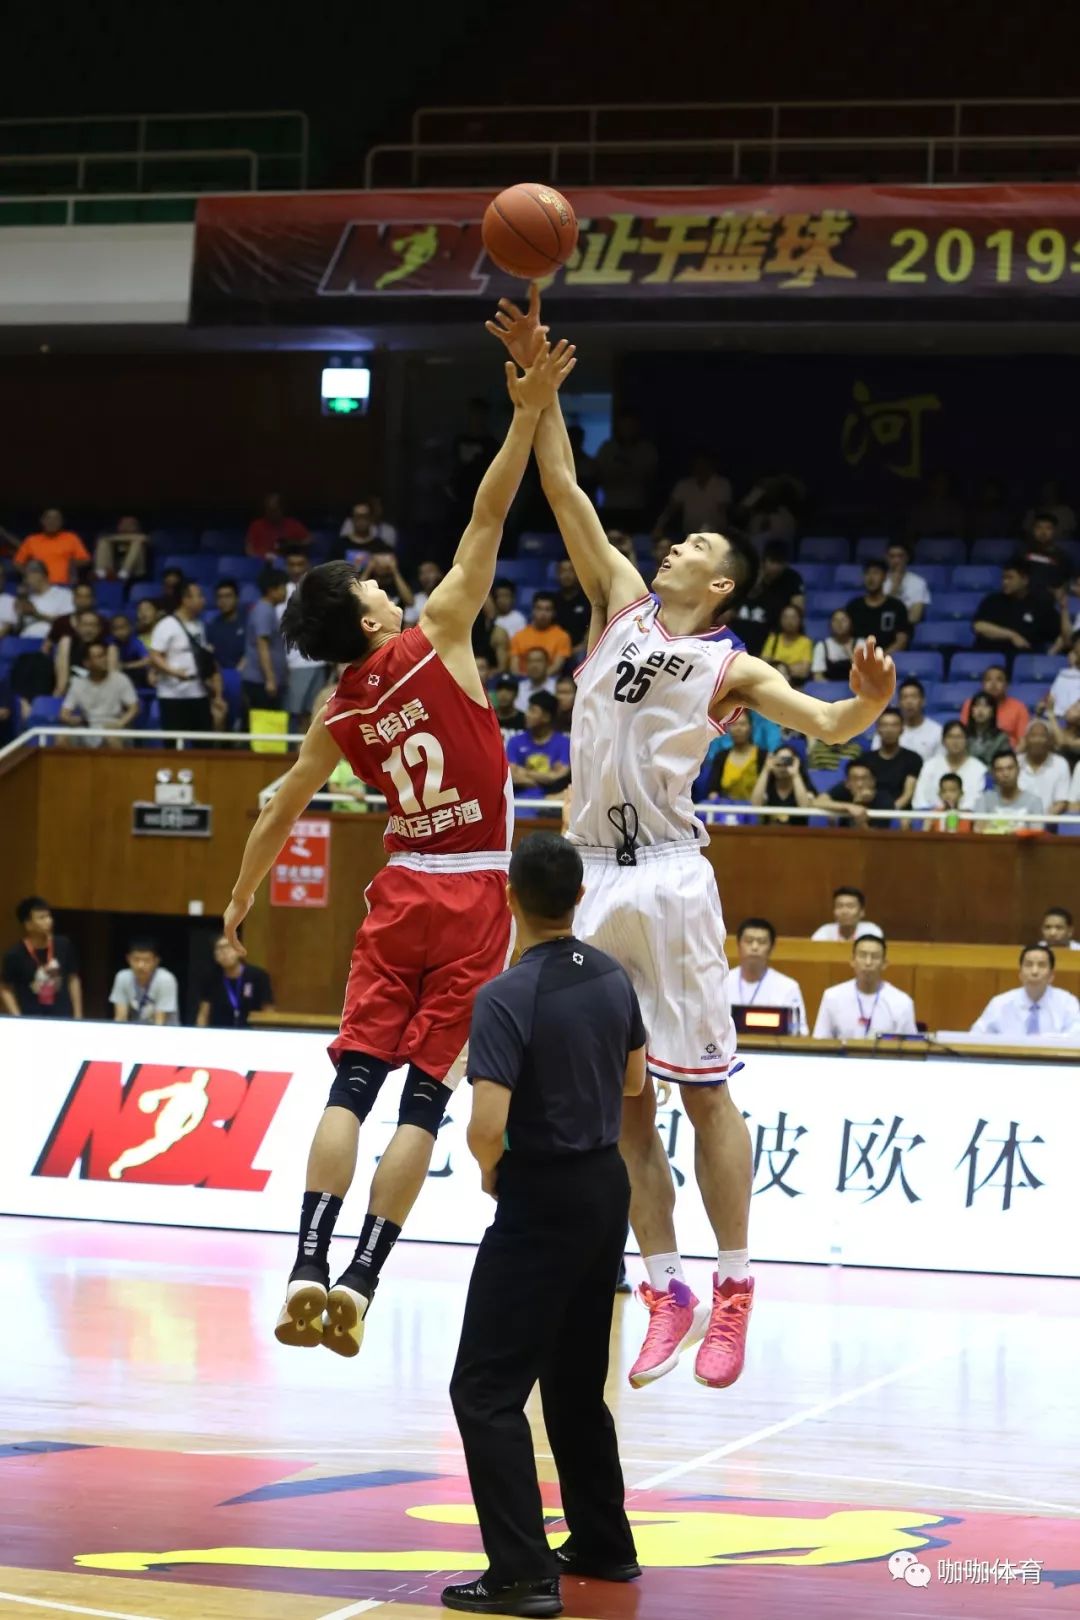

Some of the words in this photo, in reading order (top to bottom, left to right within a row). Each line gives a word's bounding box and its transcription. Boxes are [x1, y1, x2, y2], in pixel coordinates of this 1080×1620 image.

[534, 209, 857, 289] 止于篮球
[614, 660, 657, 704] 25
[381, 732, 460, 815] 12
[31, 1060, 293, 1192] NBL
